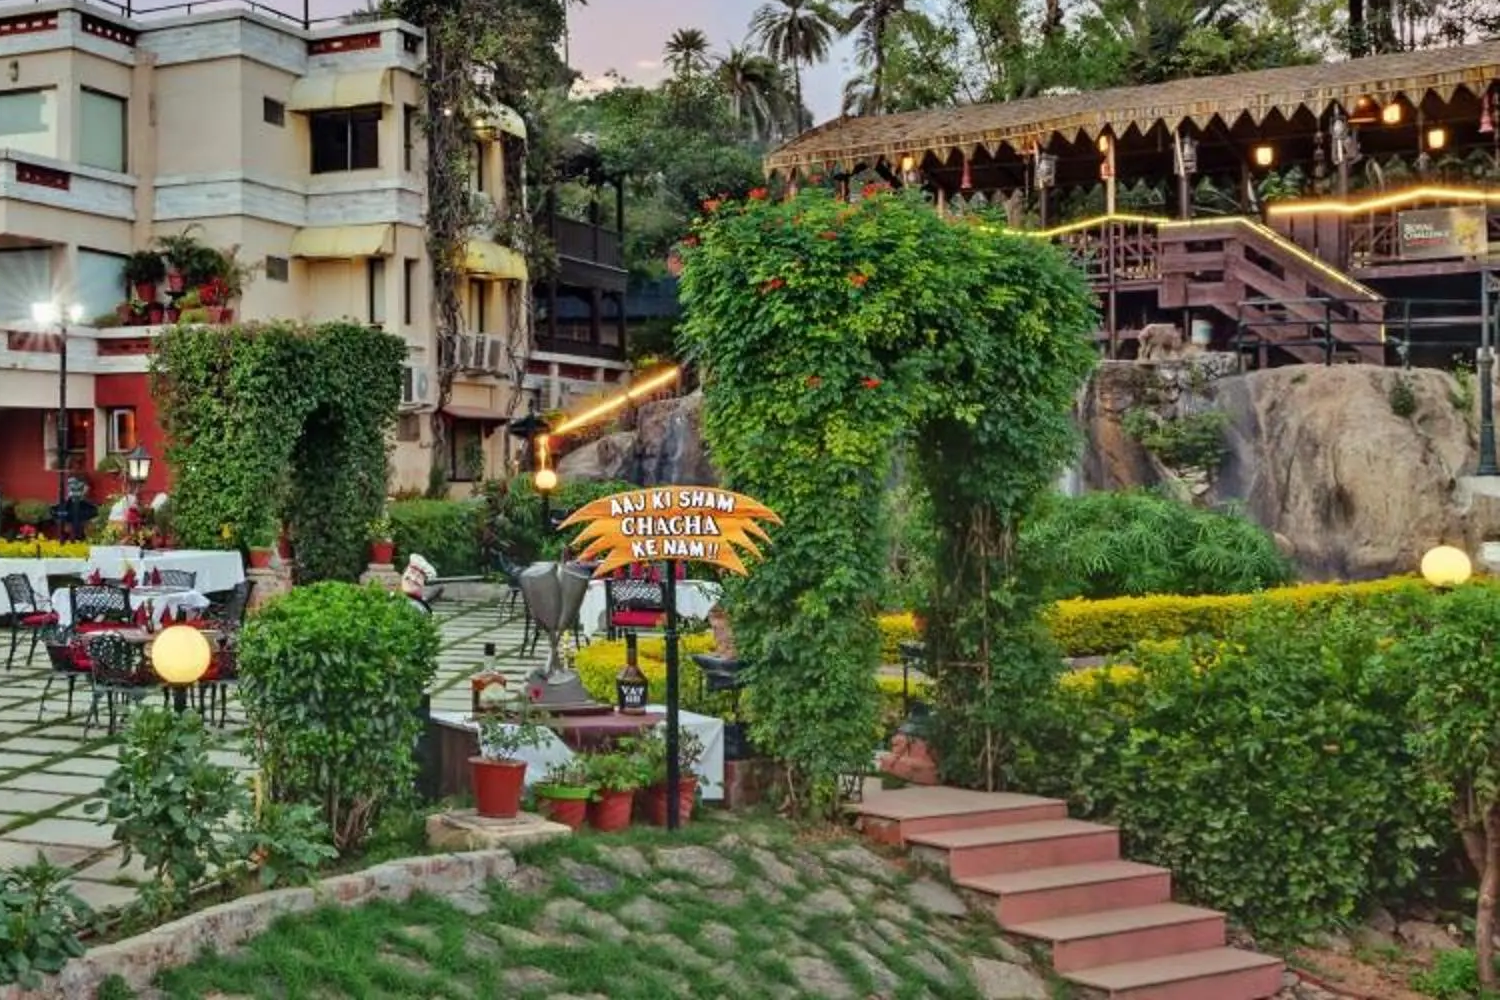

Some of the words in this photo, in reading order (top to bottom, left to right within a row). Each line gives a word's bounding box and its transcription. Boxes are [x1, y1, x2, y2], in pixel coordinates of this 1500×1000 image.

[611, 495, 645, 516] AAJ
[653, 491, 671, 509] KI
[679, 491, 734, 512] SHAM
[621, 515, 720, 535] CHACHA
[632, 539, 657, 557] KE
